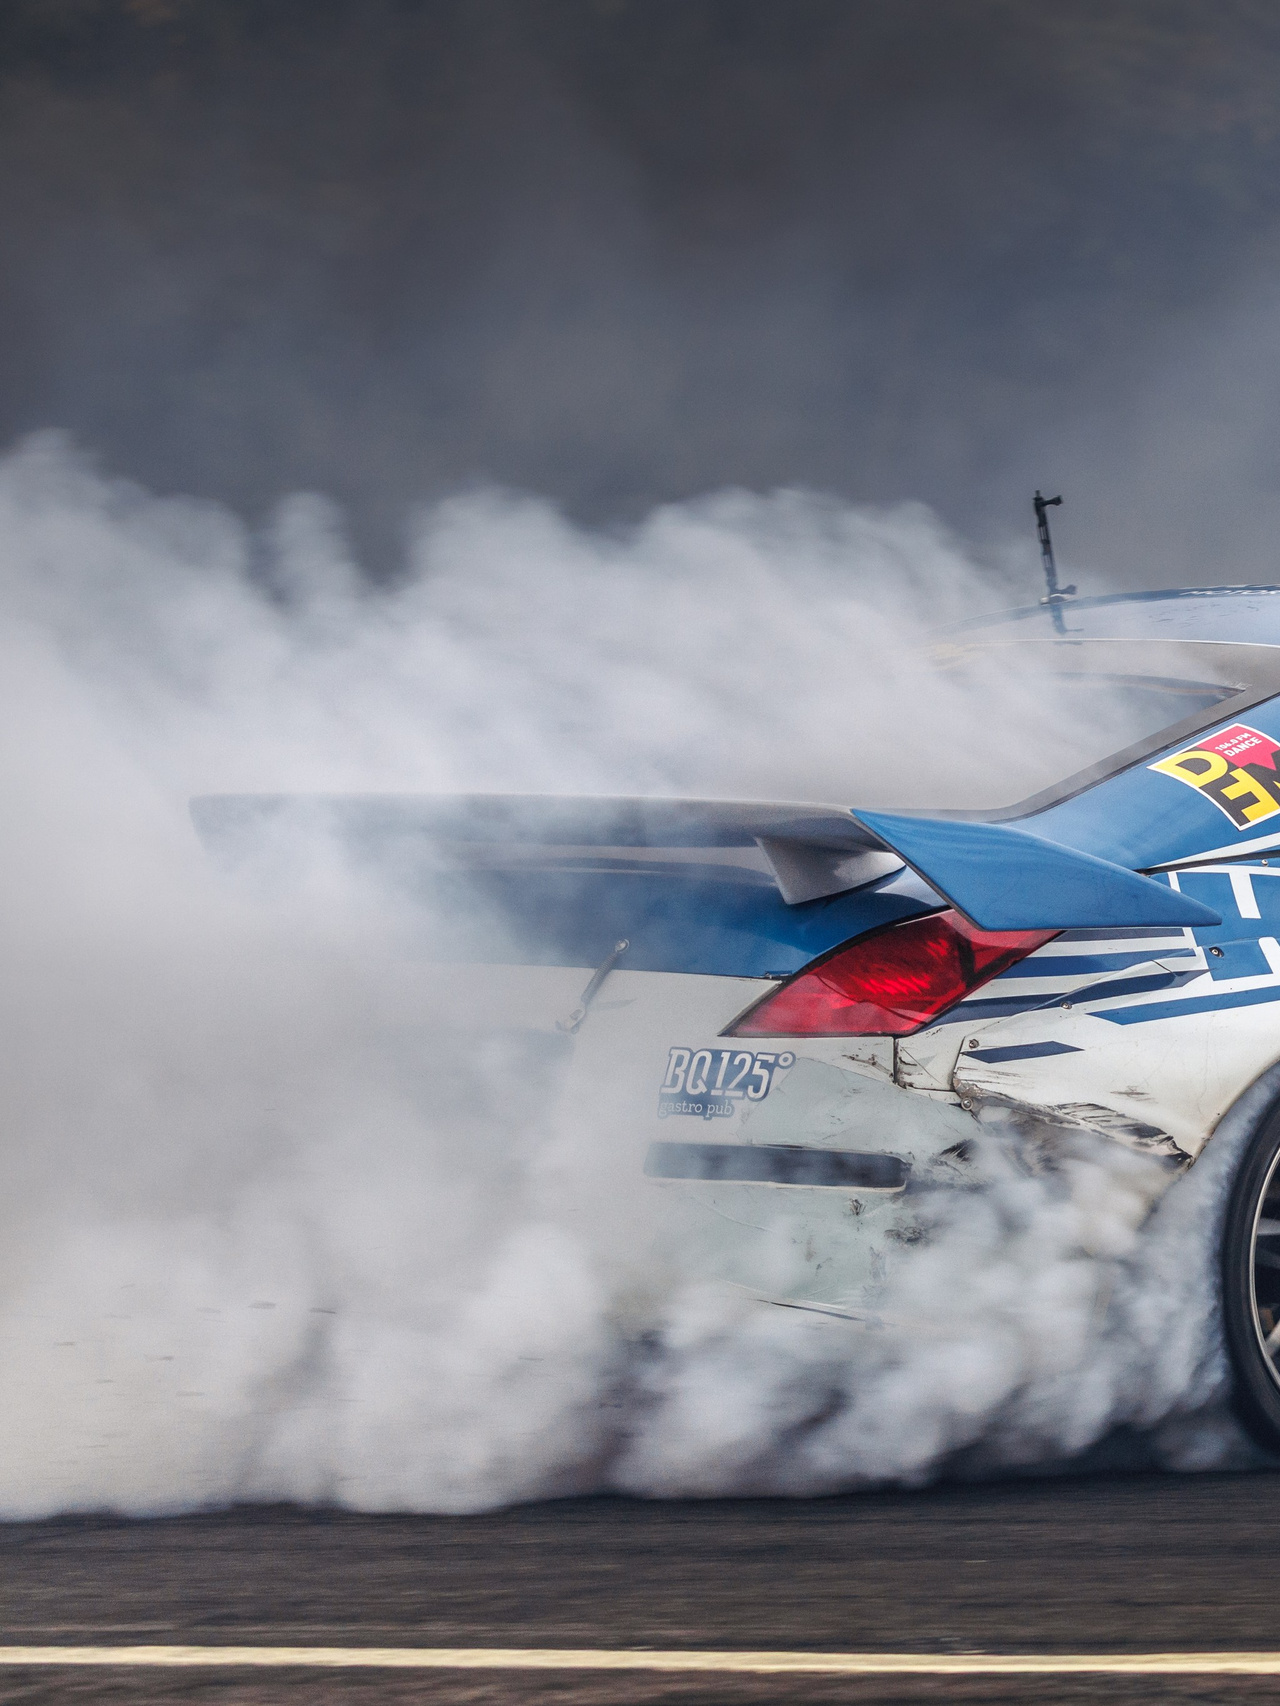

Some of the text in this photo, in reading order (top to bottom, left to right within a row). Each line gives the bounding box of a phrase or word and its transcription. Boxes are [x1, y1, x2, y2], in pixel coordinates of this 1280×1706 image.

[1223, 736, 1262, 756] DANCE
[659, 1099, 733, 1117] gastro pub
